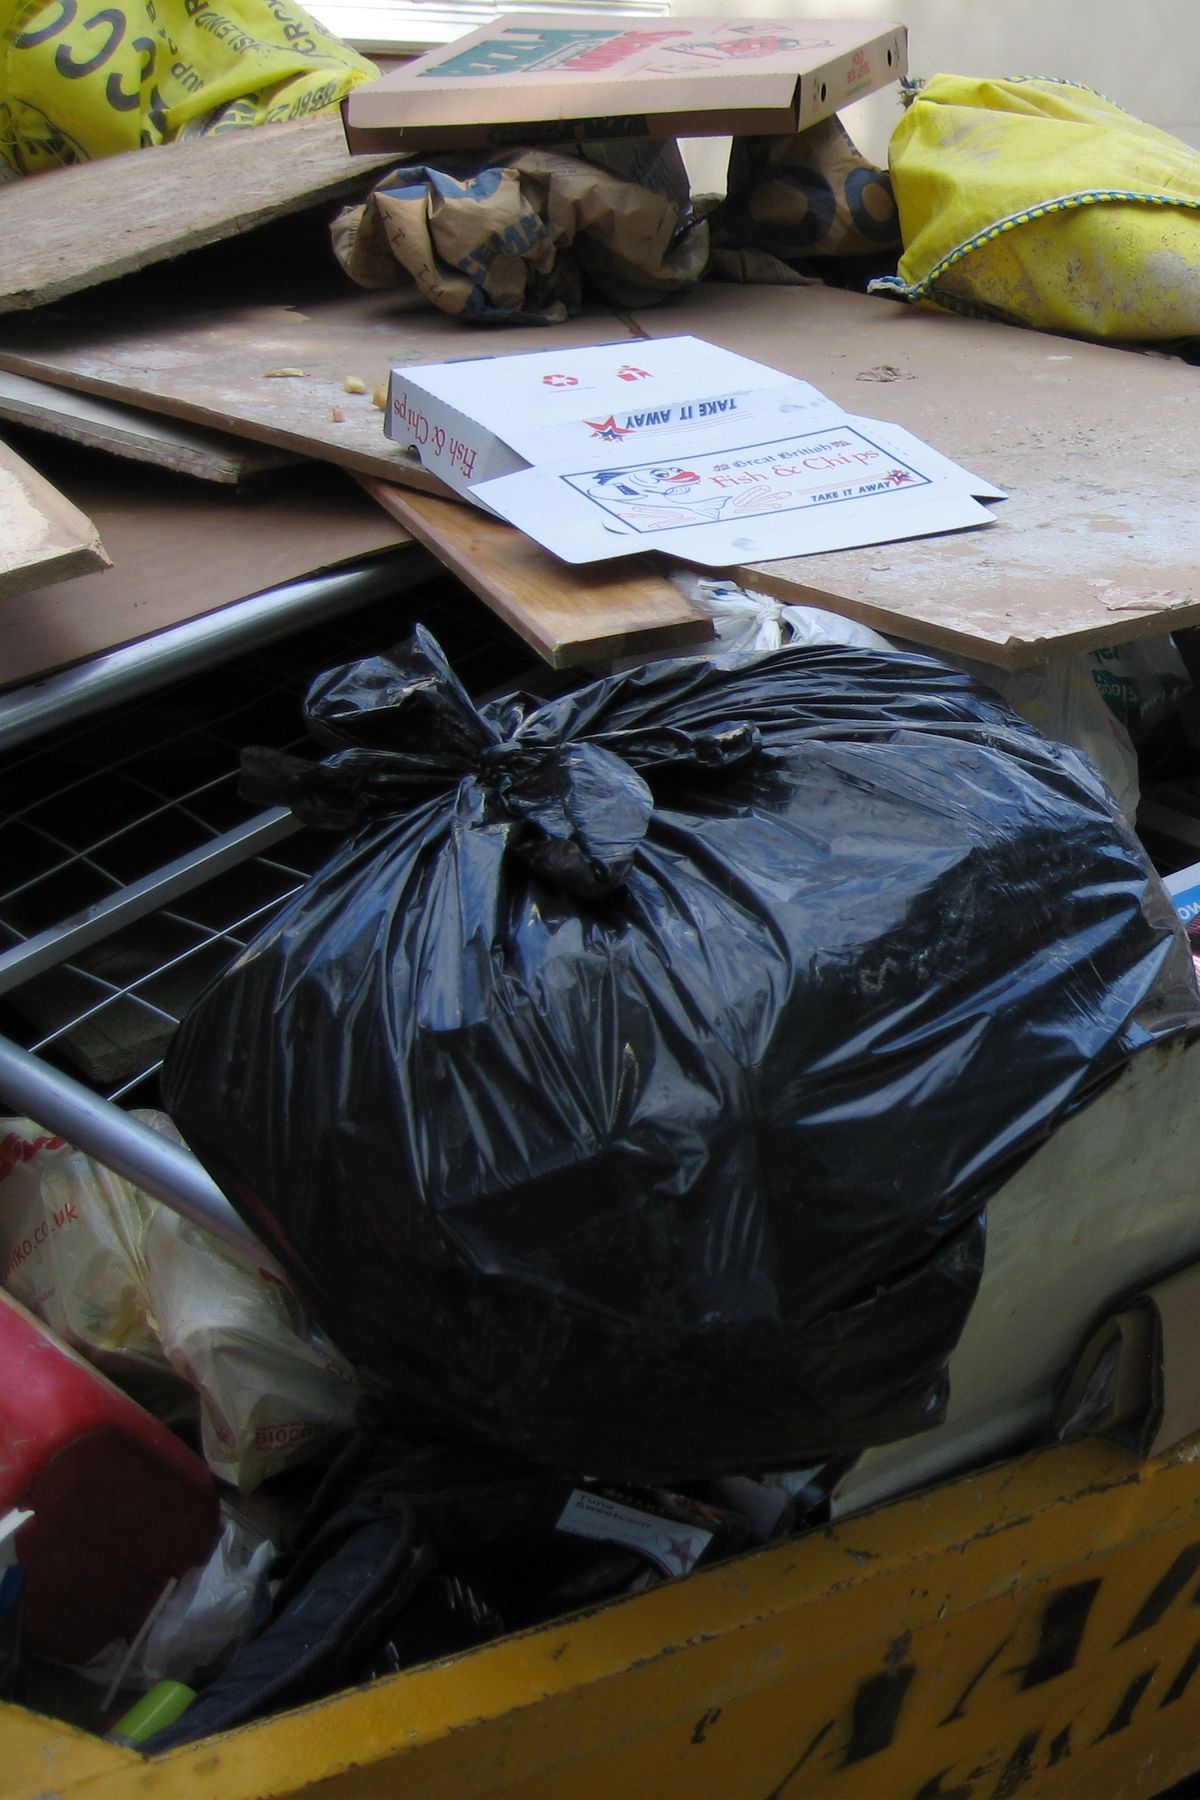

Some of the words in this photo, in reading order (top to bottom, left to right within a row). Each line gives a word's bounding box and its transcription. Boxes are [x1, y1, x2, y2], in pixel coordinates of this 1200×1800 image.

[393, 392, 429, 445] Chips
[625, 408, 672, 430] AWAY
[679, 405, 693, 421] IT
[699, 398, 738, 416] TAKE
[450, 438, 479, 479] Fish
[732, 454, 777, 469] Great
[777, 442, 833, 461] British
[707, 469, 770, 489] Fish
[771, 463, 803, 478] &
[802, 448, 881, 472] Chips
[810, 491, 840, 503] TAKE
[843, 487, 853, 498] IT
[858, 480, 892, 494] AWAY
